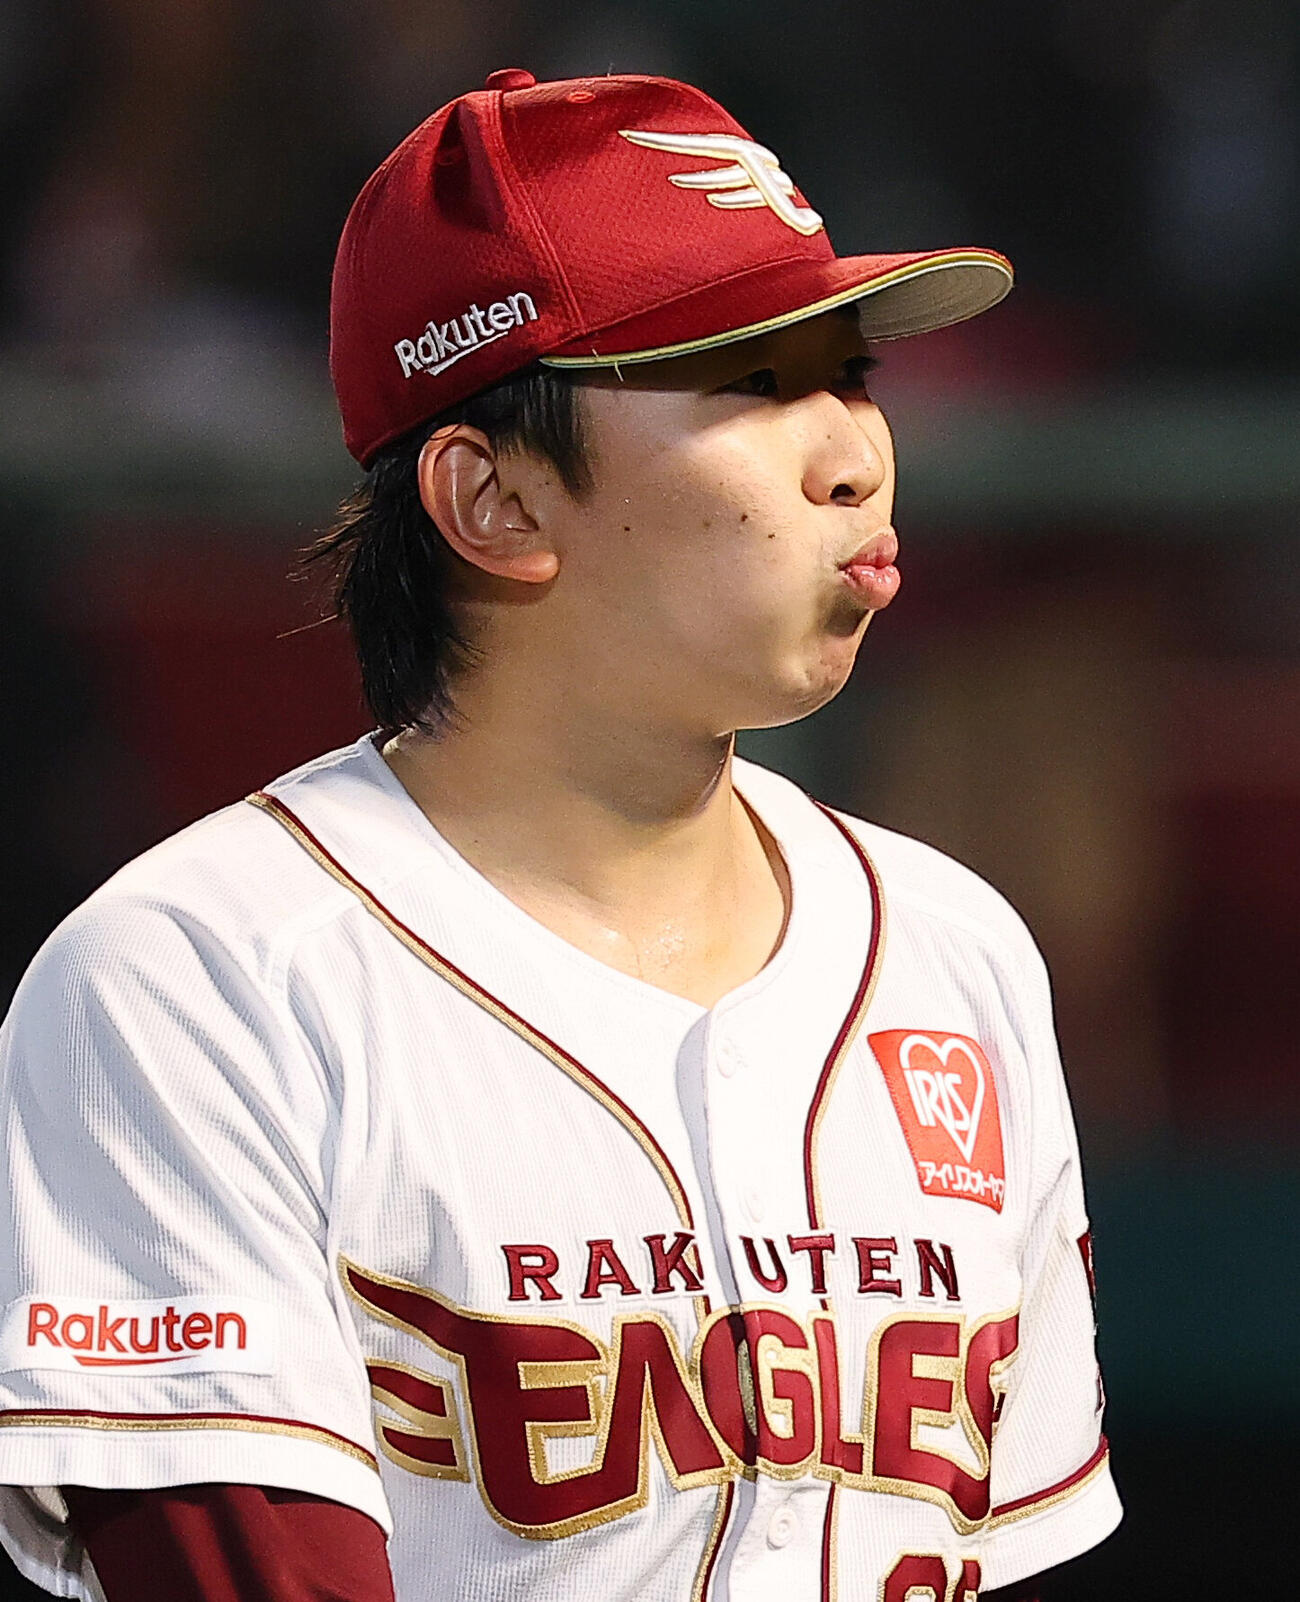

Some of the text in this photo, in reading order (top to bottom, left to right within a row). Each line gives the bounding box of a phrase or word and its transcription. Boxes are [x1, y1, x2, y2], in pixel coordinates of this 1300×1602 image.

[394, 291, 538, 378] Rakuten
[904, 1069, 971, 1131] IRIS
[27, 1302, 246, 1353] Rakuten
